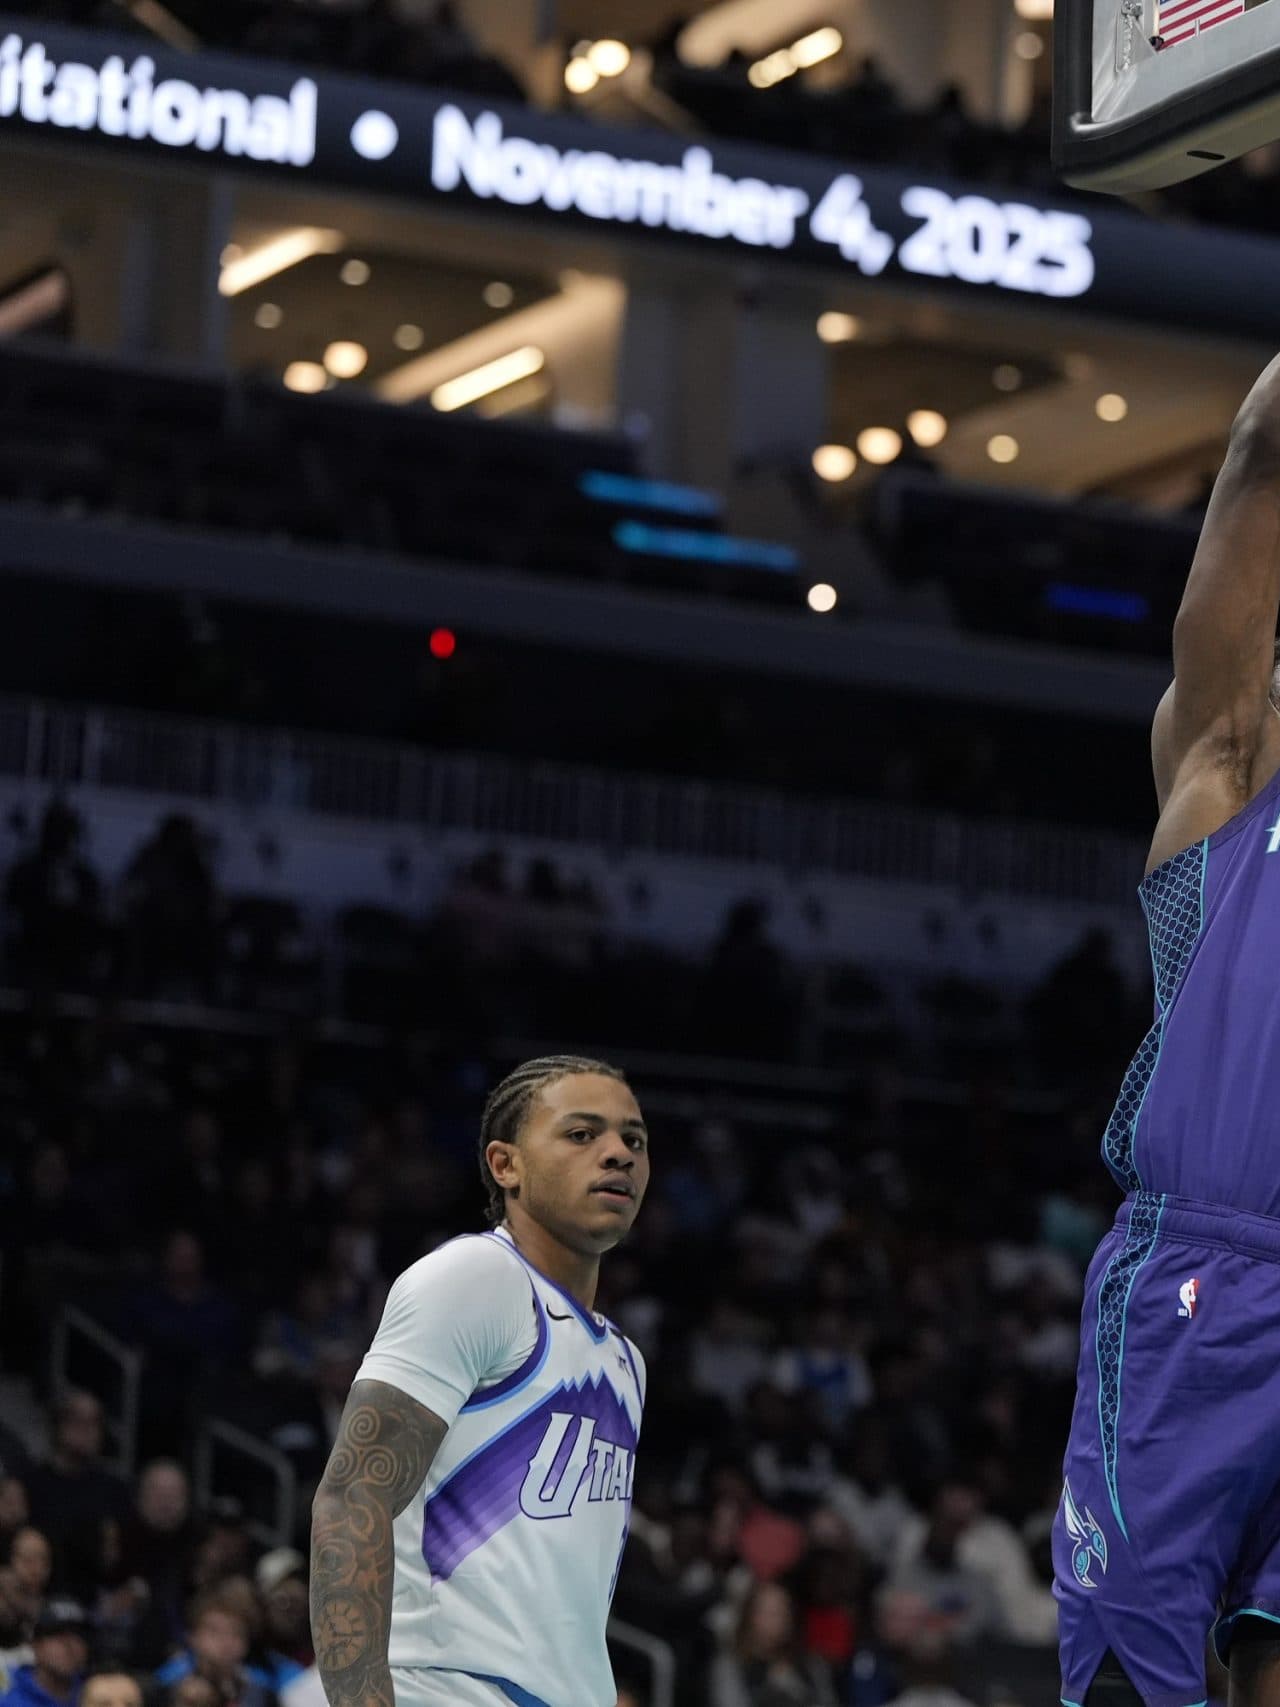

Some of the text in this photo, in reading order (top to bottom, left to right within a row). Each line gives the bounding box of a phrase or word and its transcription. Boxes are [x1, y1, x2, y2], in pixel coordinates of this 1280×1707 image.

[431, 104, 809, 252] November
[810, 174, 894, 275] 4,
[898, 187, 1094, 297] 2025
[518, 1411, 637, 1520] UTA
